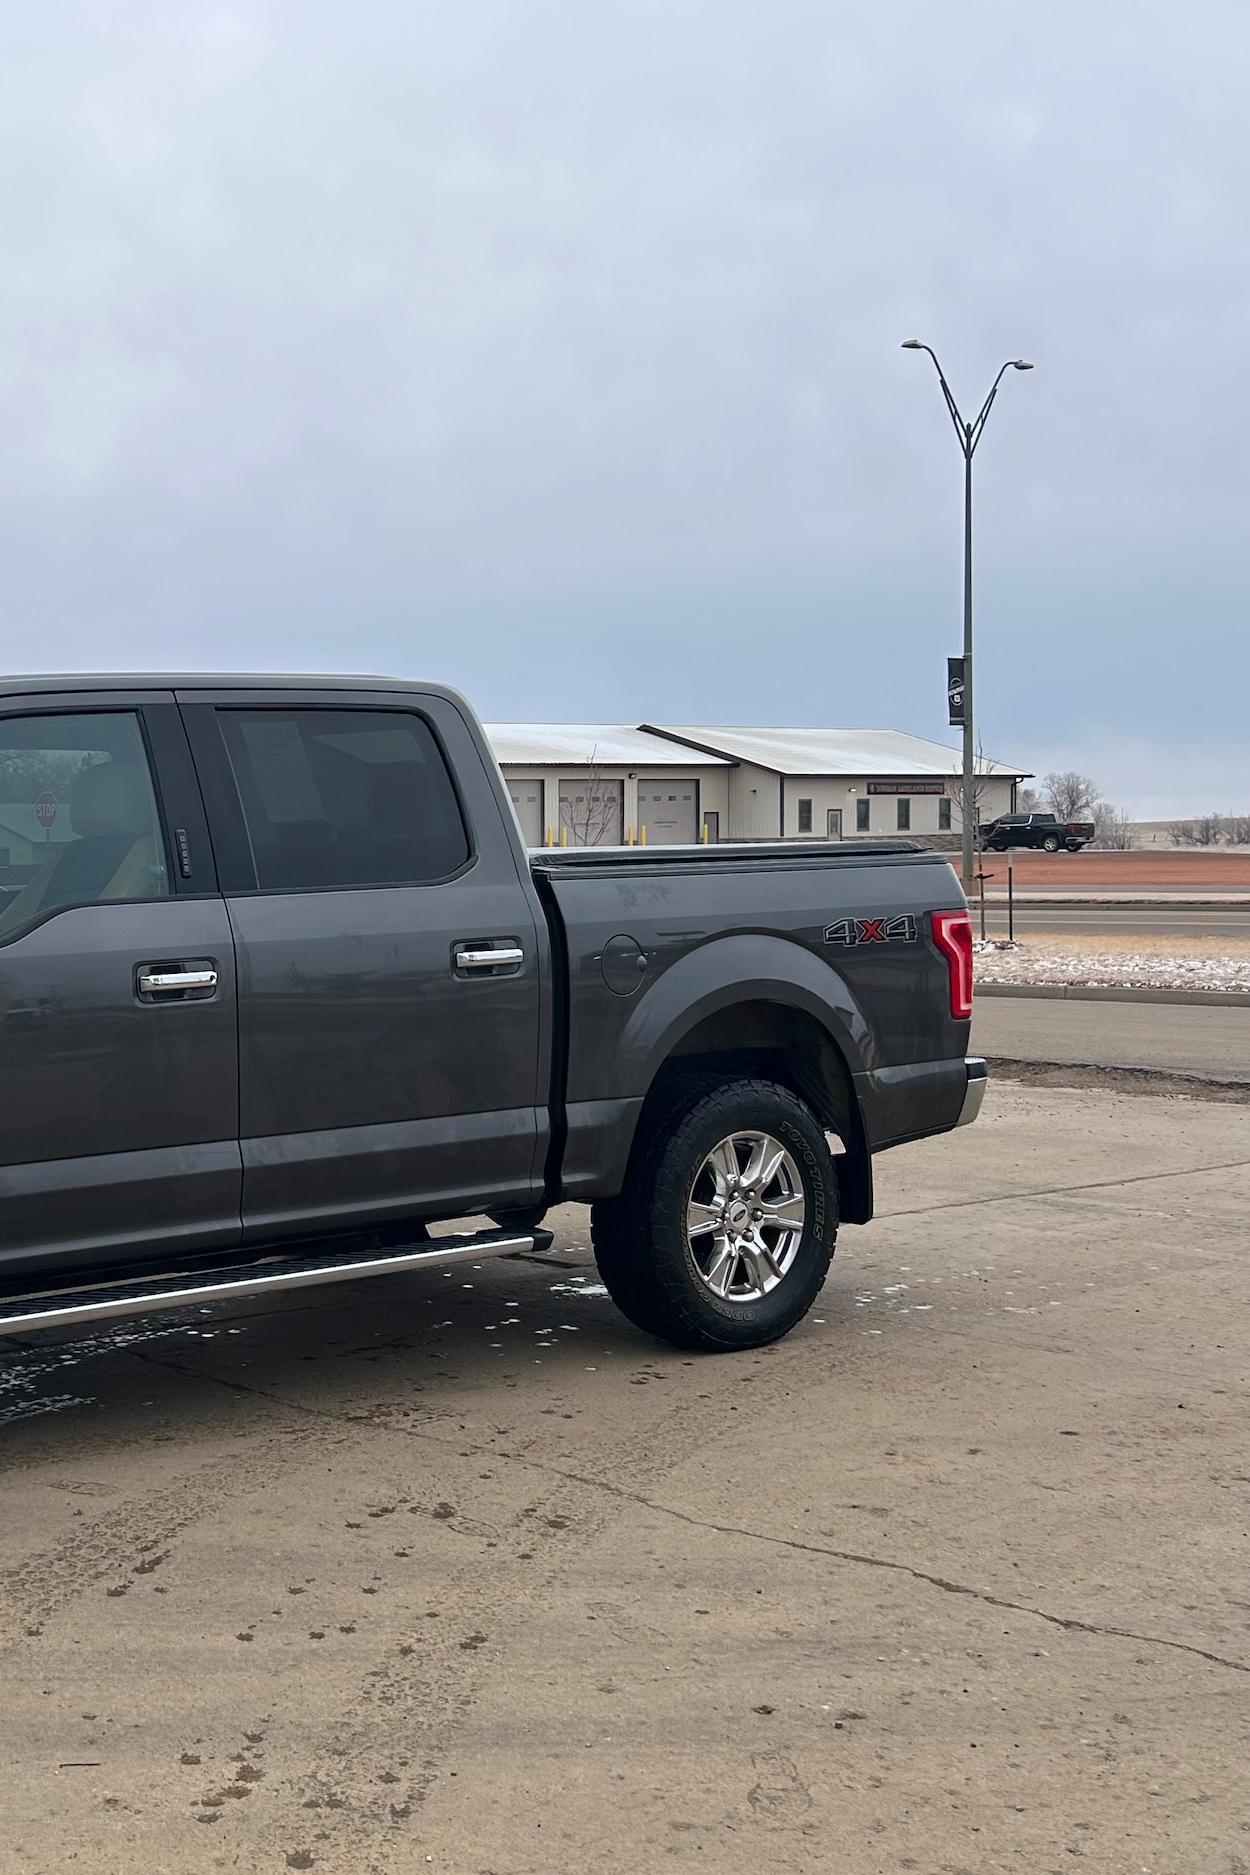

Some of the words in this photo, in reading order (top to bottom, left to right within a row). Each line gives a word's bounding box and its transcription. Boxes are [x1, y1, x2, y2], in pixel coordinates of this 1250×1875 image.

[37, 803, 56, 817] STOP
[778, 1120, 817, 1165] TOYO
[810, 1166, 825, 1242] TIRES
